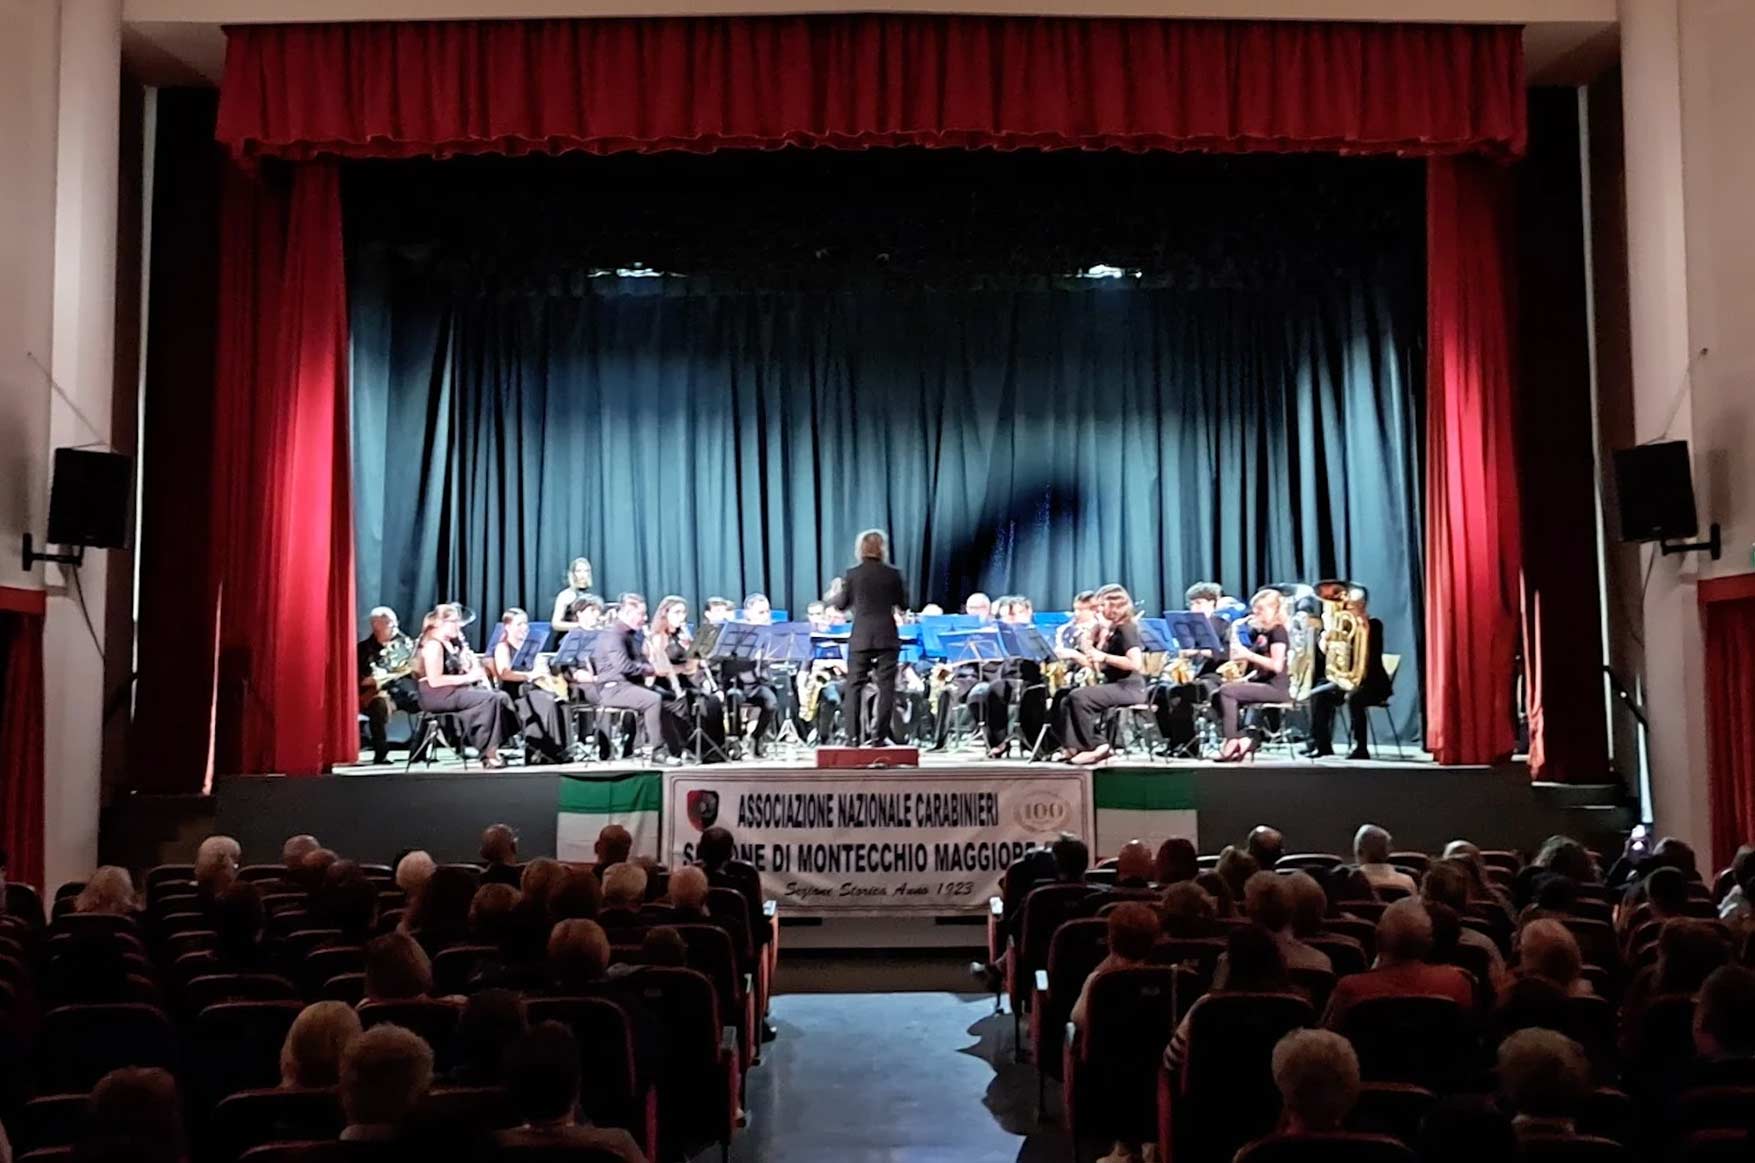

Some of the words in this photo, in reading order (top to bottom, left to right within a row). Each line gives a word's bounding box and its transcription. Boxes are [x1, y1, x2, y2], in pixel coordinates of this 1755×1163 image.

[737, 792, 834, 829] ASSOCIAZIONE
[838, 792, 912, 829] NAZIONALE
[915, 792, 999, 828] CARABINIERI
[1025, 802, 1064, 820] 100
[772, 843, 790, 873] DI
[798, 842, 927, 873] MONTECCHIO
[893, 882, 929, 897] Anno
